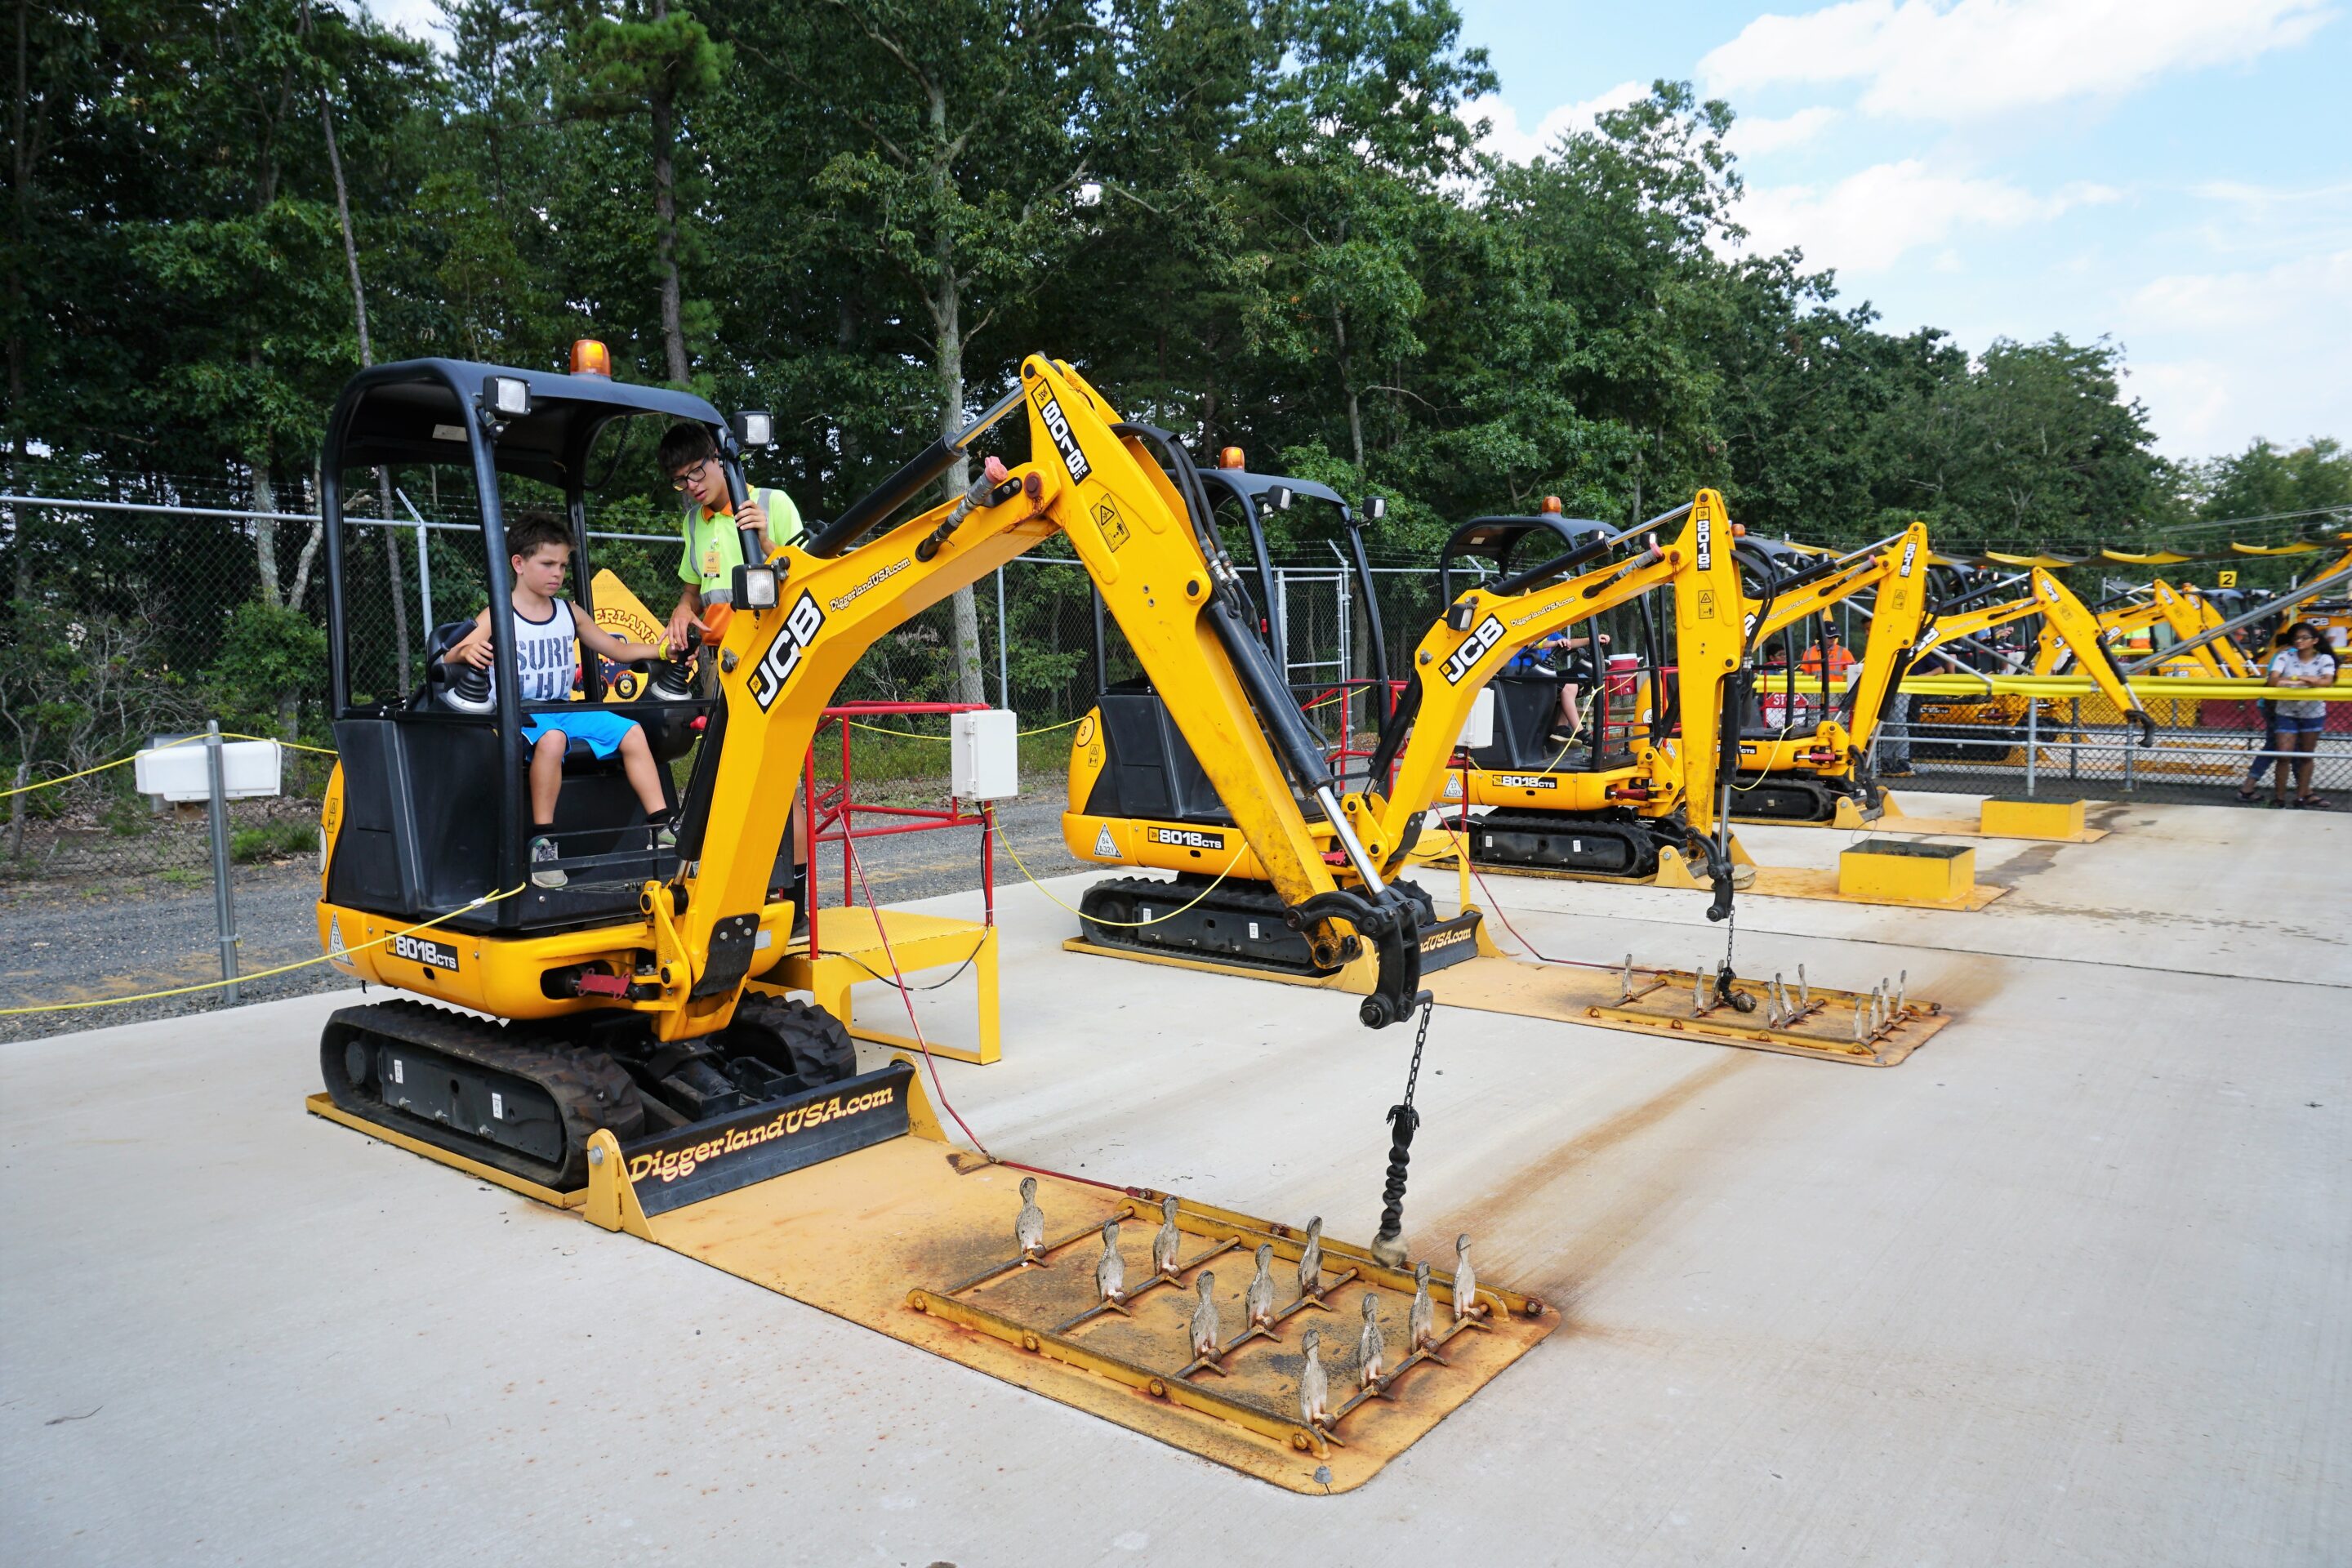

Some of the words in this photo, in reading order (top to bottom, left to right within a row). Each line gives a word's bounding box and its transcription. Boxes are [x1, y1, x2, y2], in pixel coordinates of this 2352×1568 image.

[1042, 400, 1085, 474] 8018
[1074, 465, 1088, 479] CTS
[1698, 519, 1710, 564] 8018
[829, 558, 911, 612] DiggerlandUSA.com
[2222, 574, 2233, 585] 2
[594, 608, 659, 644] ERLAND
[1511, 596, 1575, 626] DiggerlandUSA.com
[516, 635, 574, 671] SURF
[758, 596, 822, 706] JCB
[1447, 617, 1504, 683] JCB
[1773, 694, 1800, 706] STP
[1080, 725, 1087, 737] 3
[630, 1085, 893, 1183] DiggerlandUSA.com
